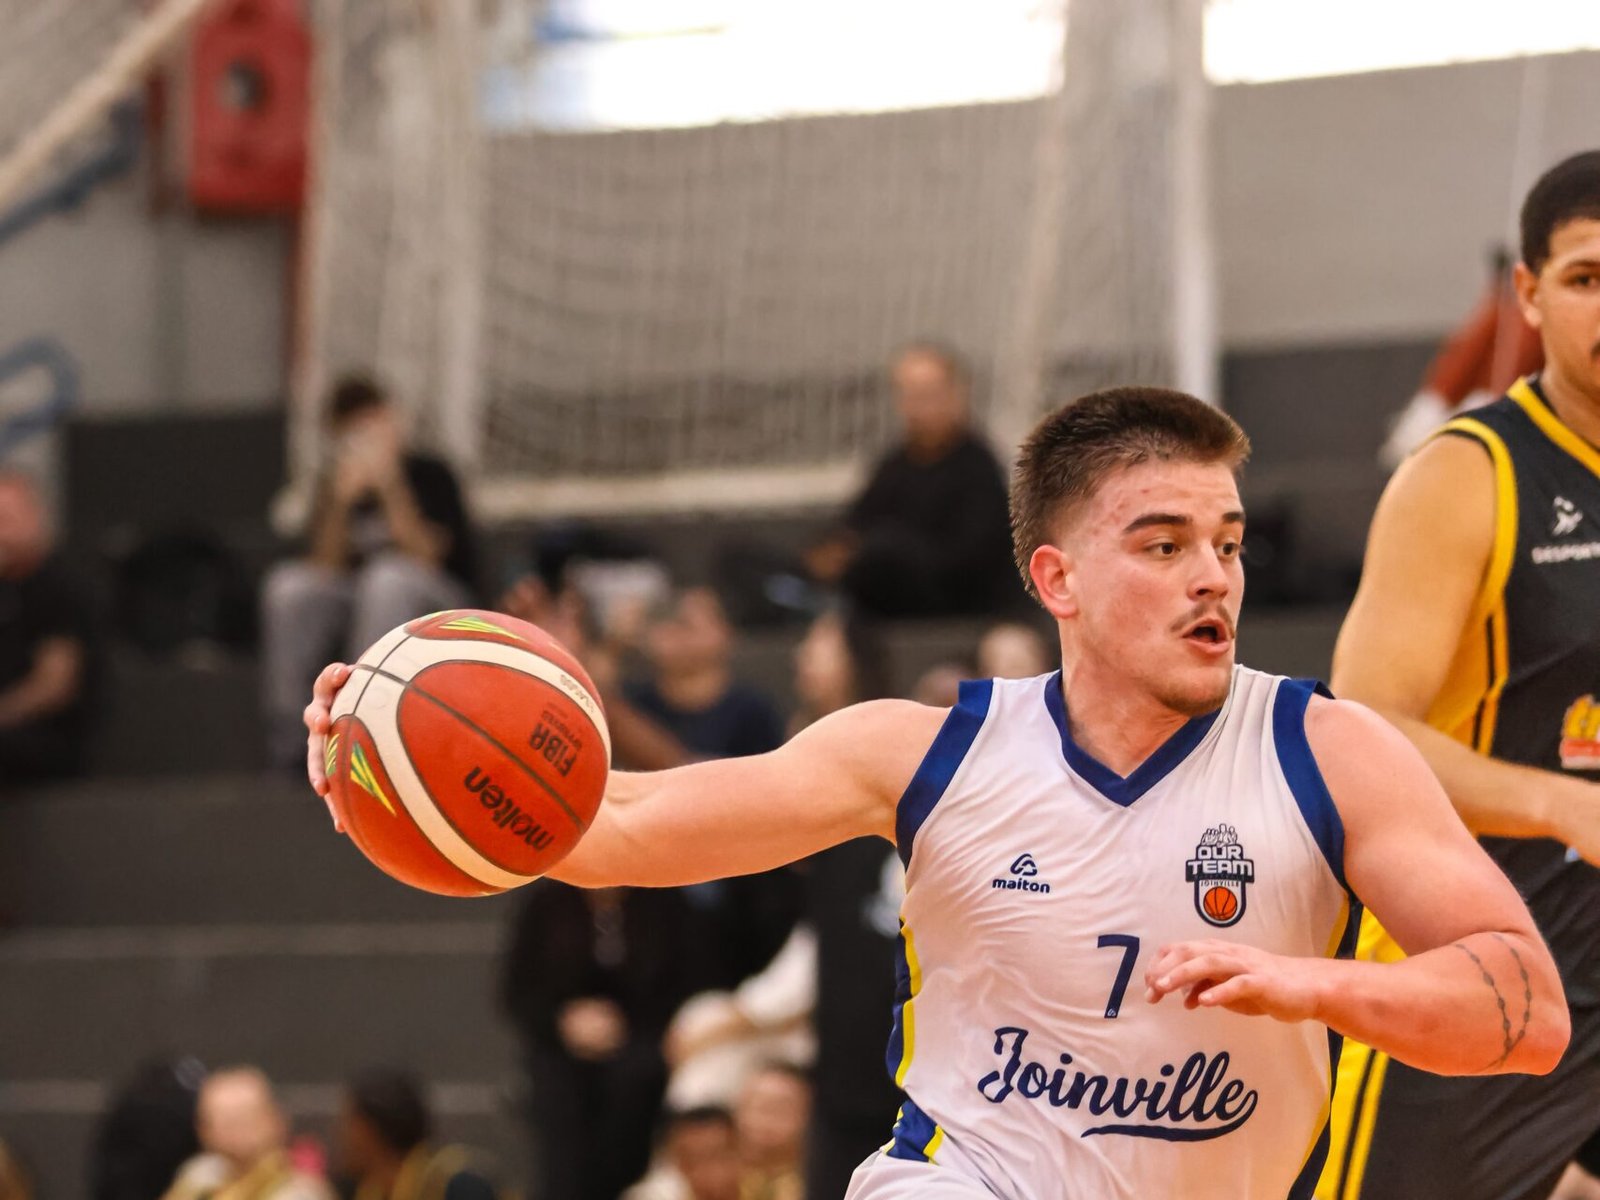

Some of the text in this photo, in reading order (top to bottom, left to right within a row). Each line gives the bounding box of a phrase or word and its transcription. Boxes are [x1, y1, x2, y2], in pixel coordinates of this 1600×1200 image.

[528, 722, 579, 778] FIBA
[464, 766, 555, 853] molten
[1187, 860, 1253, 876] TEAM
[1197, 845, 1242, 860] OUR
[992, 877, 1050, 894] maiton
[1097, 934, 1140, 1019] 7
[977, 1026, 1259, 1142] Joinville
